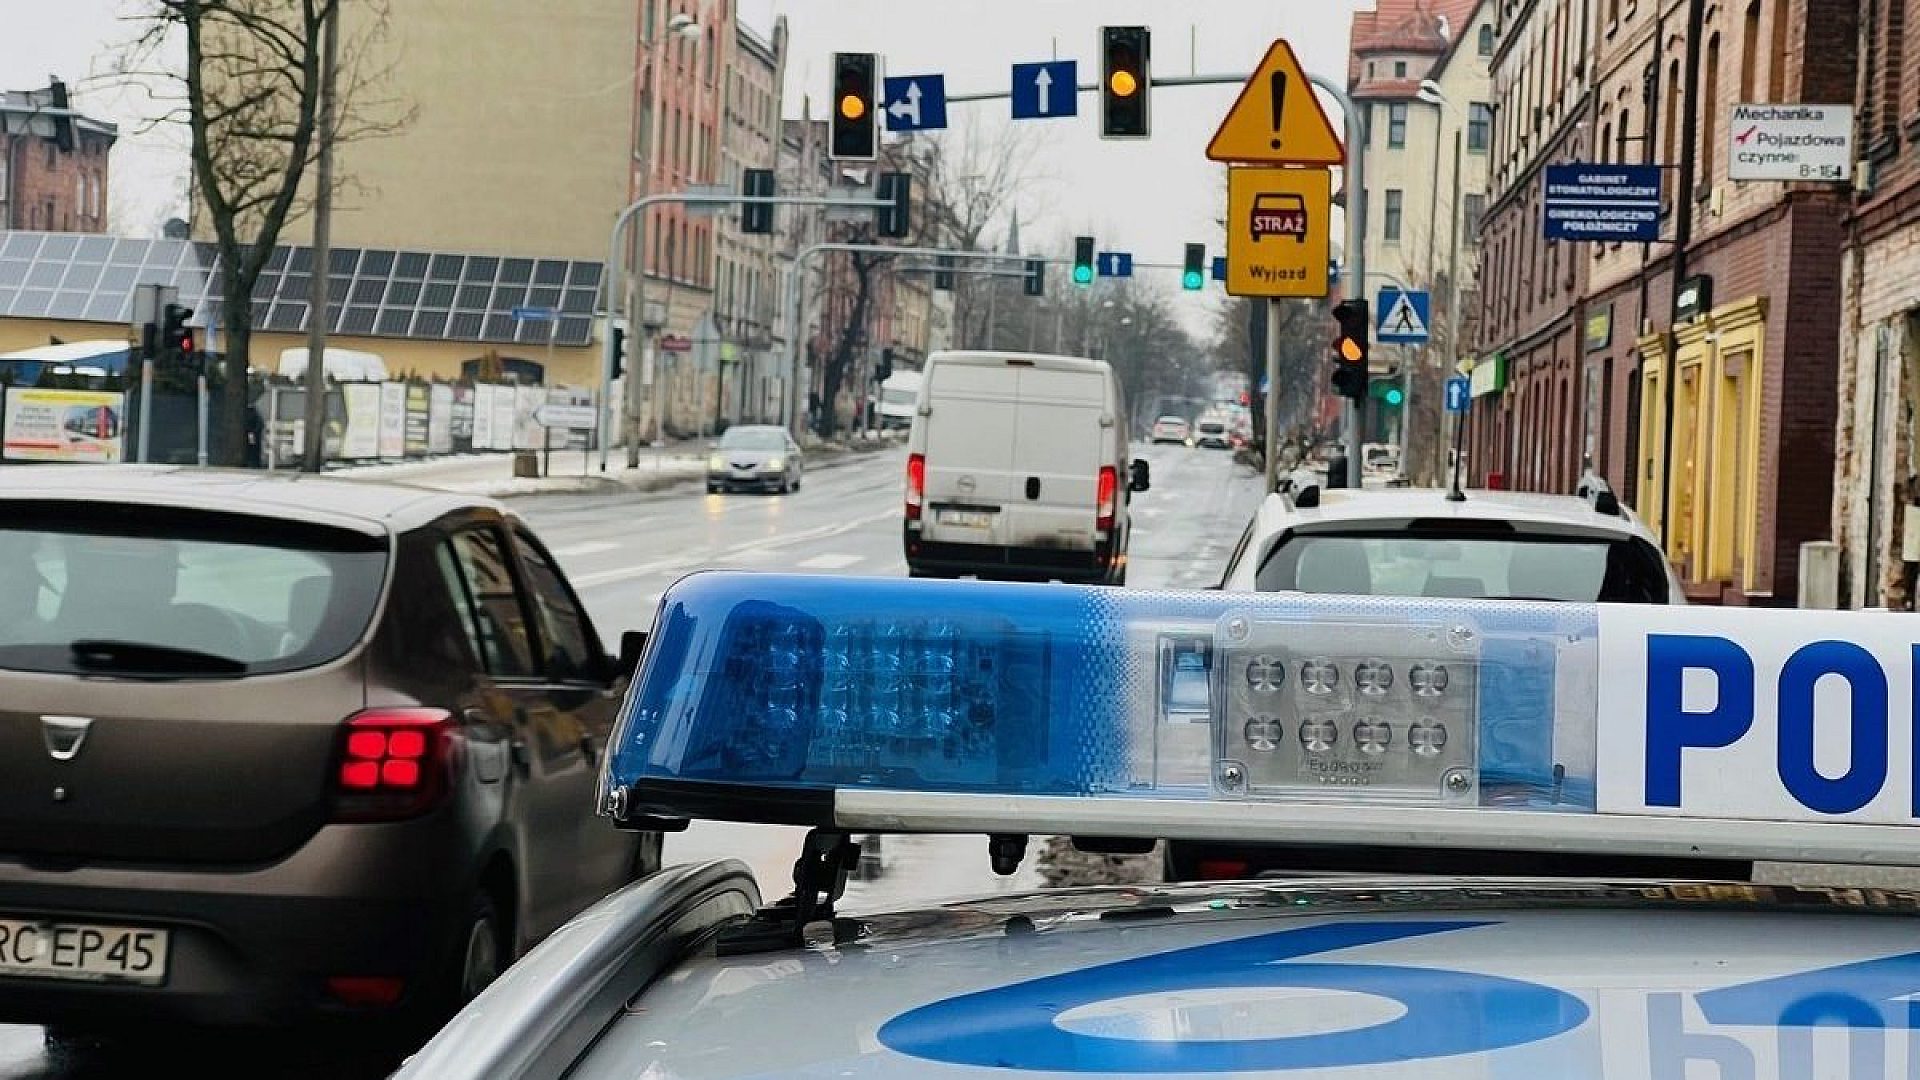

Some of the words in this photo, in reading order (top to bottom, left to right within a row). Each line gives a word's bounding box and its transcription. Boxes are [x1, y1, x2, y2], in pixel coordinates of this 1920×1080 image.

[1734, 107, 1824, 121] Mechanika
[1757, 132, 1845, 149] Pojazdowa
[1577, 174, 1628, 185] GABINET
[1547, 185, 1657, 196] STOMATOLOGICZNY
[1254, 212, 1305, 232] STRAŻ
[1249, 266, 1306, 283] Wyjazd
[1645, 633, 1920, 818] PO
[51, 928, 154, 971] EP45
